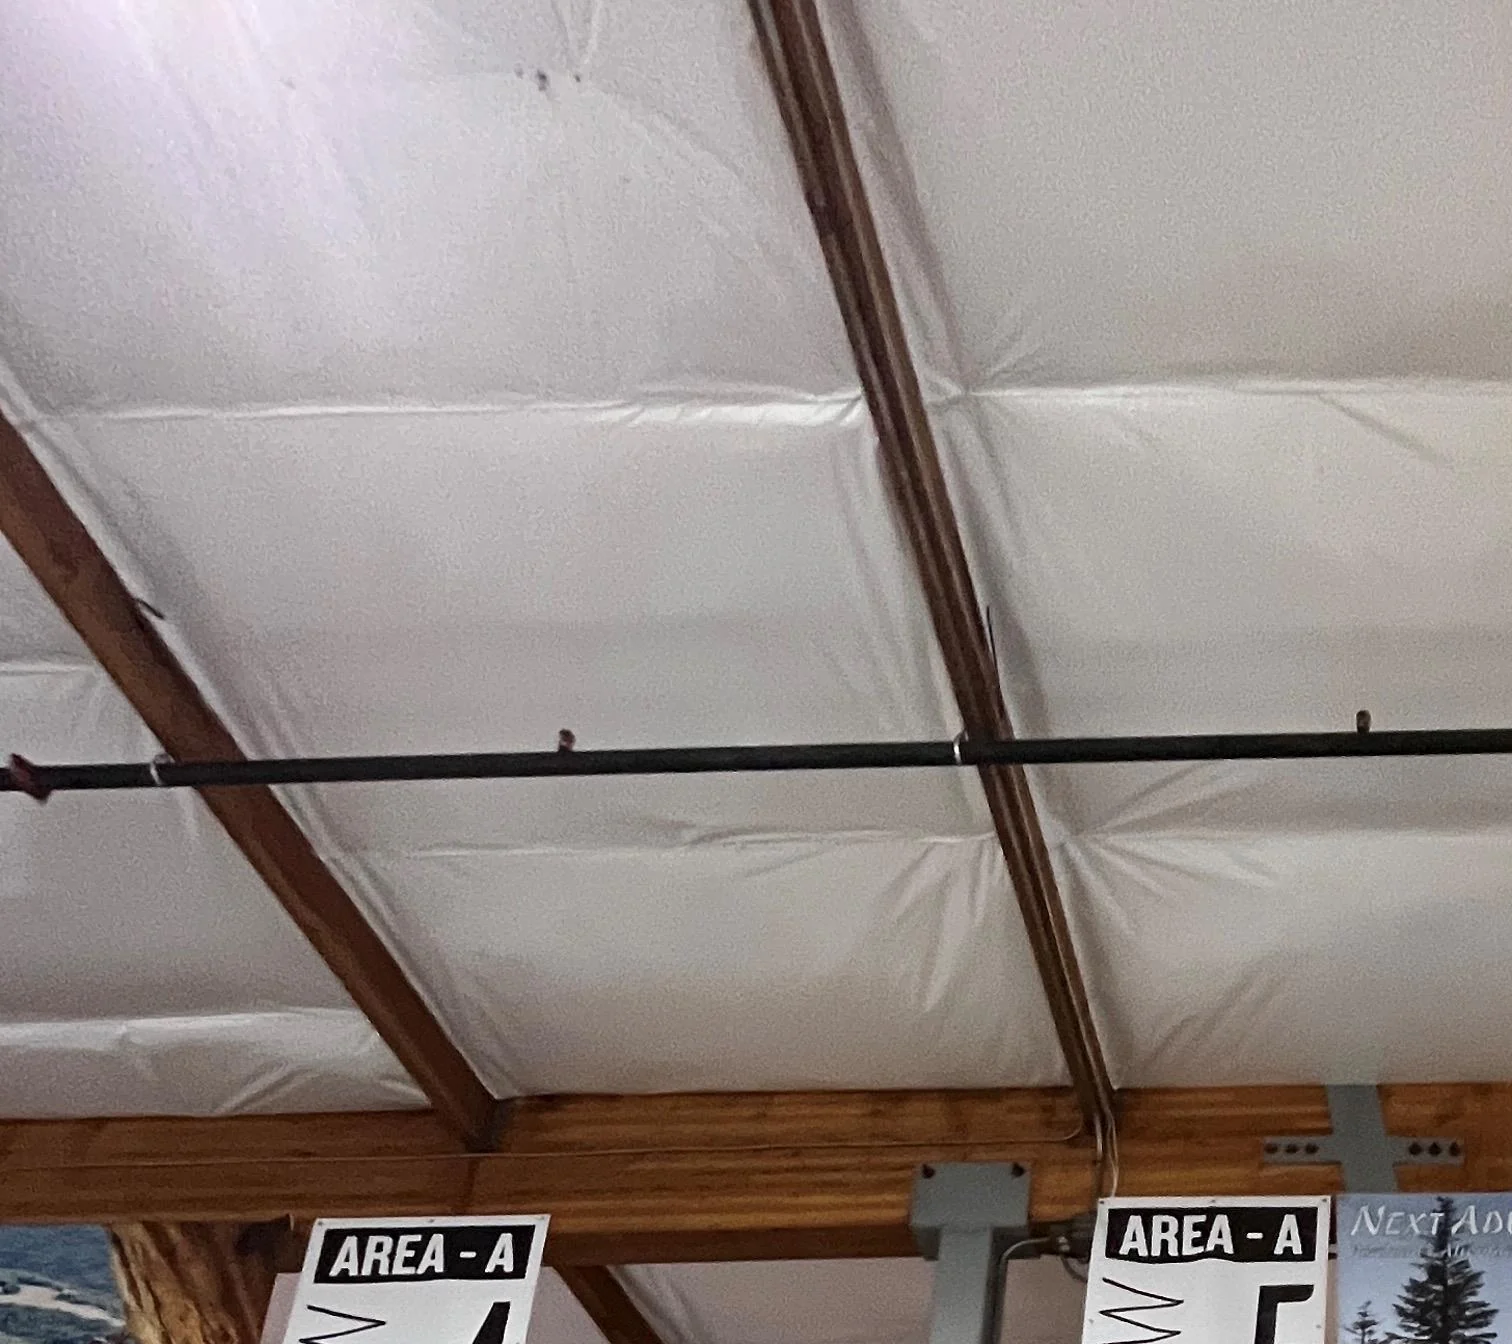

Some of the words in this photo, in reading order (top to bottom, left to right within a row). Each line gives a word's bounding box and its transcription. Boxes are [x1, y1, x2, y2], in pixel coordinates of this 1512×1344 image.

[1119, 1213, 1233, 1257] AREA
[1350, 1204, 1445, 1236] NEXT
[329, 1233, 445, 1277] AREA
